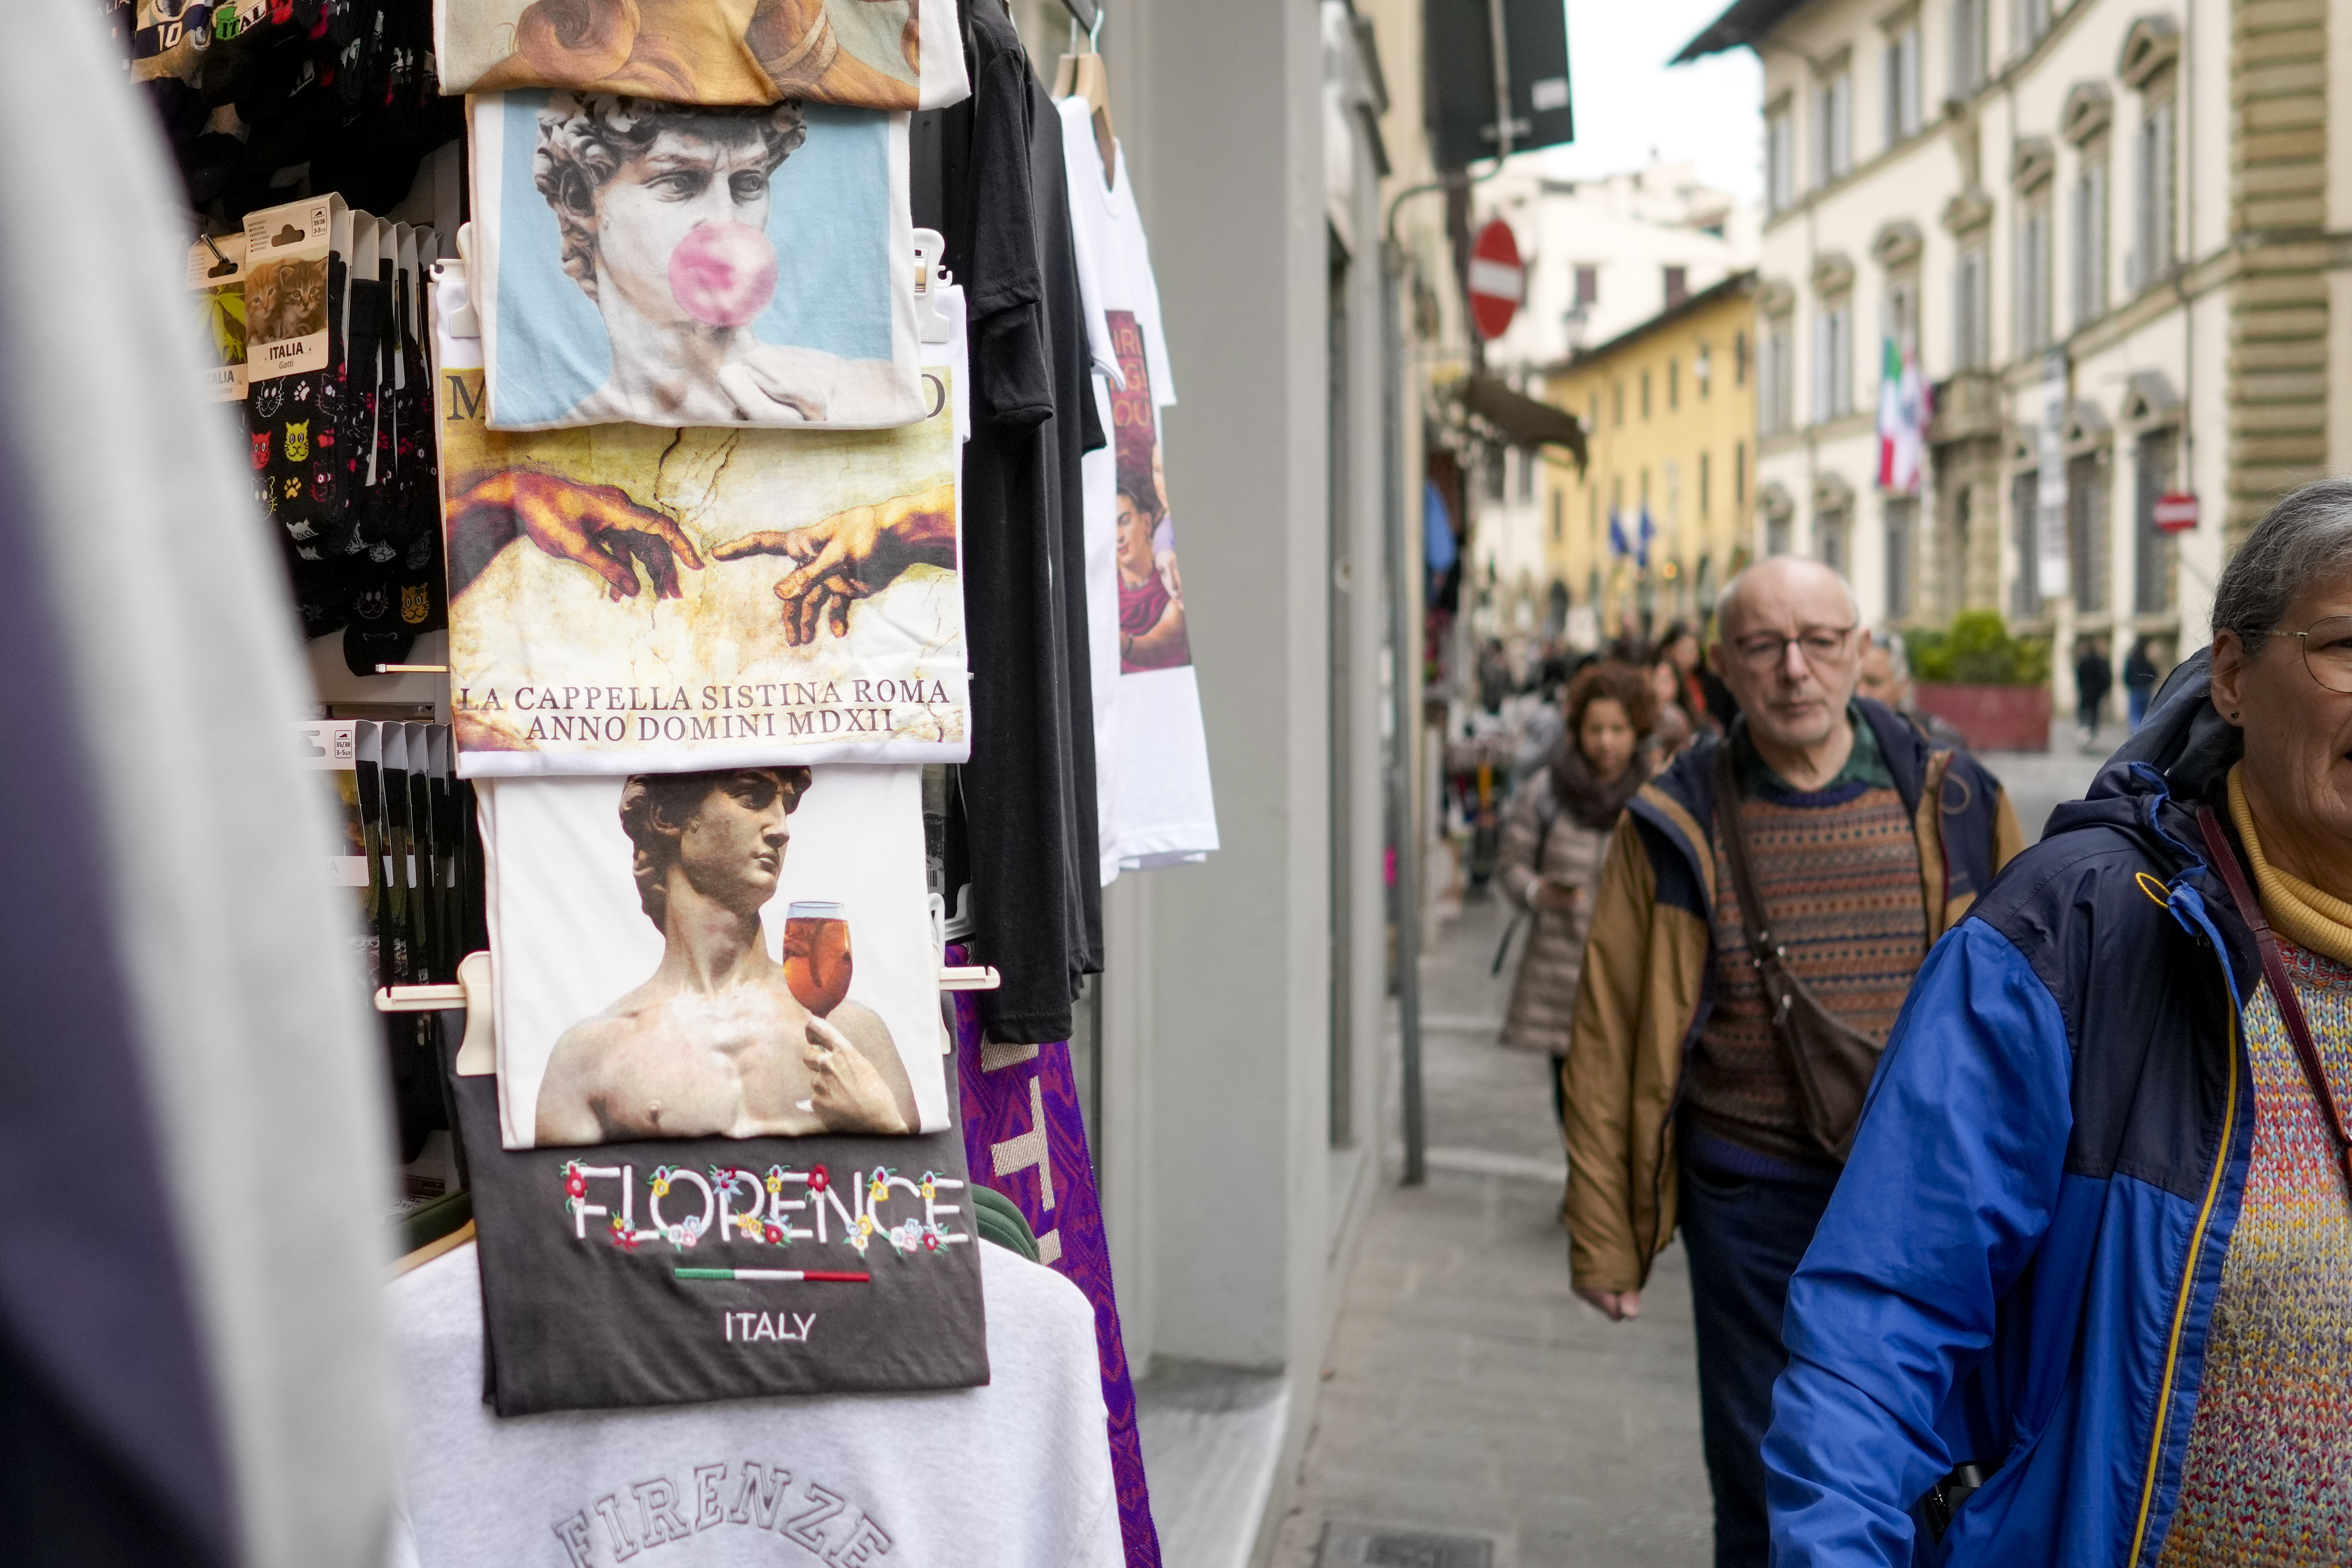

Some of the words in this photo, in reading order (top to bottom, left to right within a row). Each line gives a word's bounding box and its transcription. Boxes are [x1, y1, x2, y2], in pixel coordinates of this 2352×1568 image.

[158, 21, 183, 52] 10
[270, 342, 304, 360] ITALIA
[279, 359, 294, 369] Gatti
[203, 370, 234, 386] TALIA
[460, 688, 504, 711] LA
[515, 686, 692, 711] CAPPELLA
[702, 680, 843, 710] SISTINA
[852, 679, 950, 703] ROMA
[525, 715, 626, 741] ANNO
[638, 713, 776, 740] DOMINI
[786, 708, 893, 735] MDXII
[561, 1161, 969, 1251] FLORENCE
[725, 1311, 817, 1342] ITALY
[550, 1461, 893, 1568] FIRENZE
